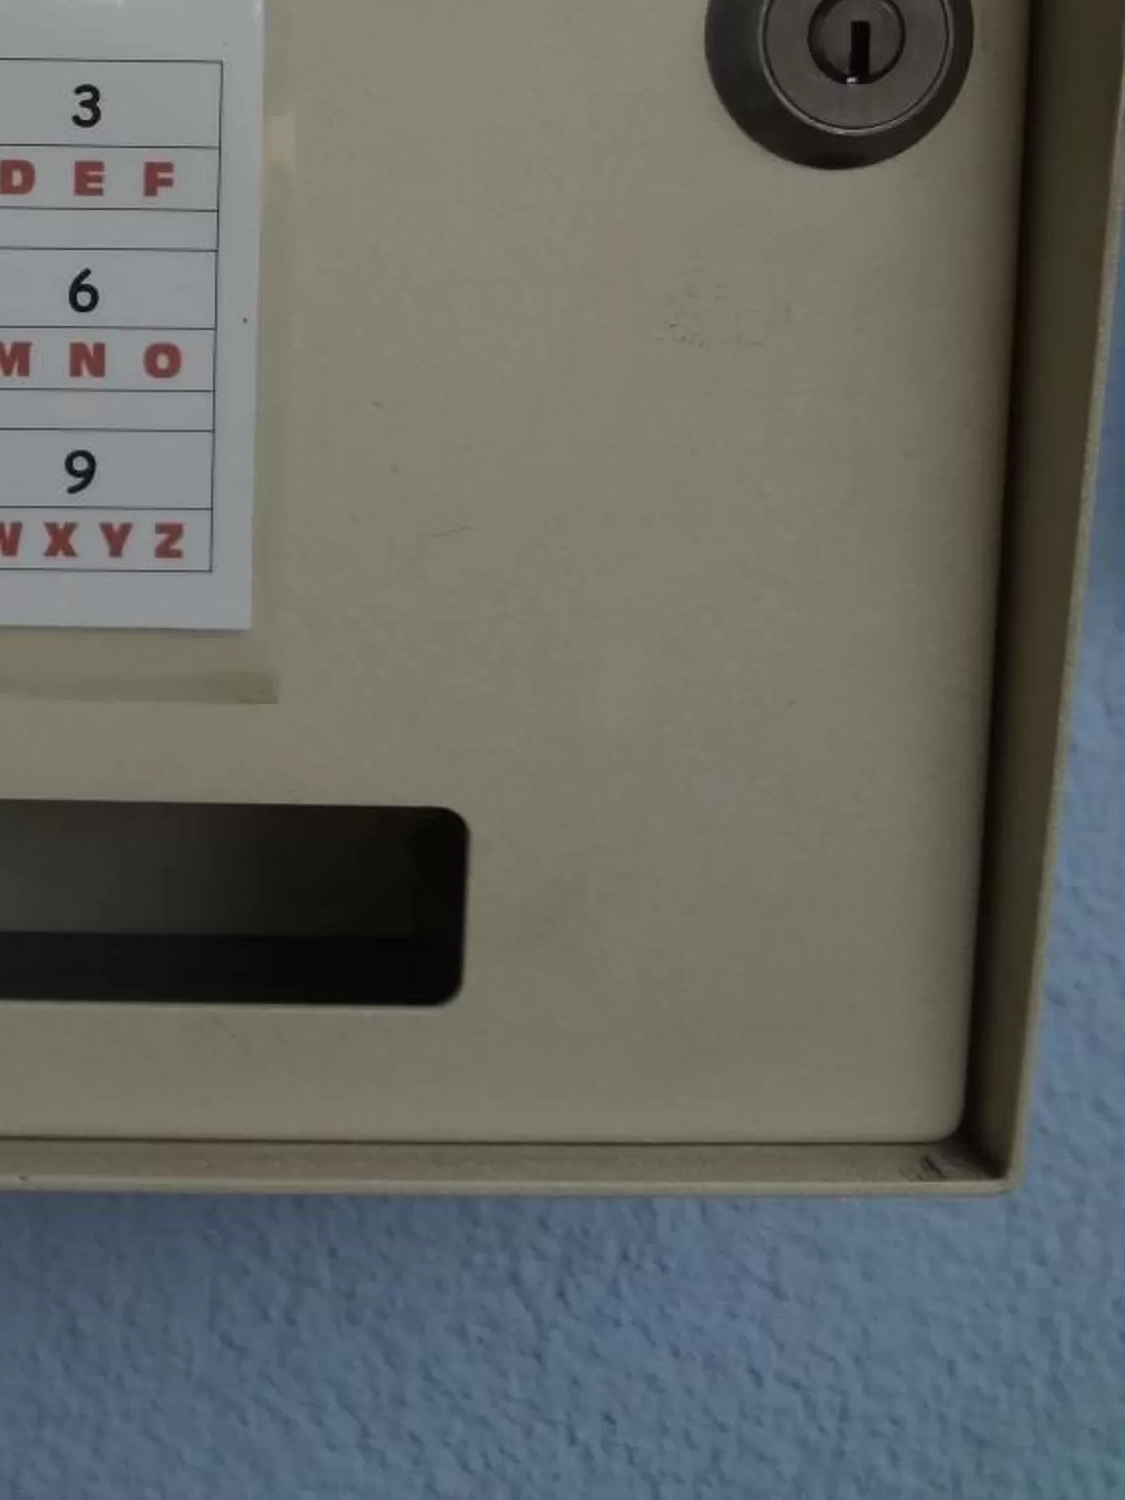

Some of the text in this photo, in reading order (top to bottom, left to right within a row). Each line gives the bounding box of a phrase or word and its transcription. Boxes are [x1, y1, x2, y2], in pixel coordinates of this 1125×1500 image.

[72, 85, 103, 128] 3
[68, 267, 100, 312] 6
[64, 450, 97, 493] 9
